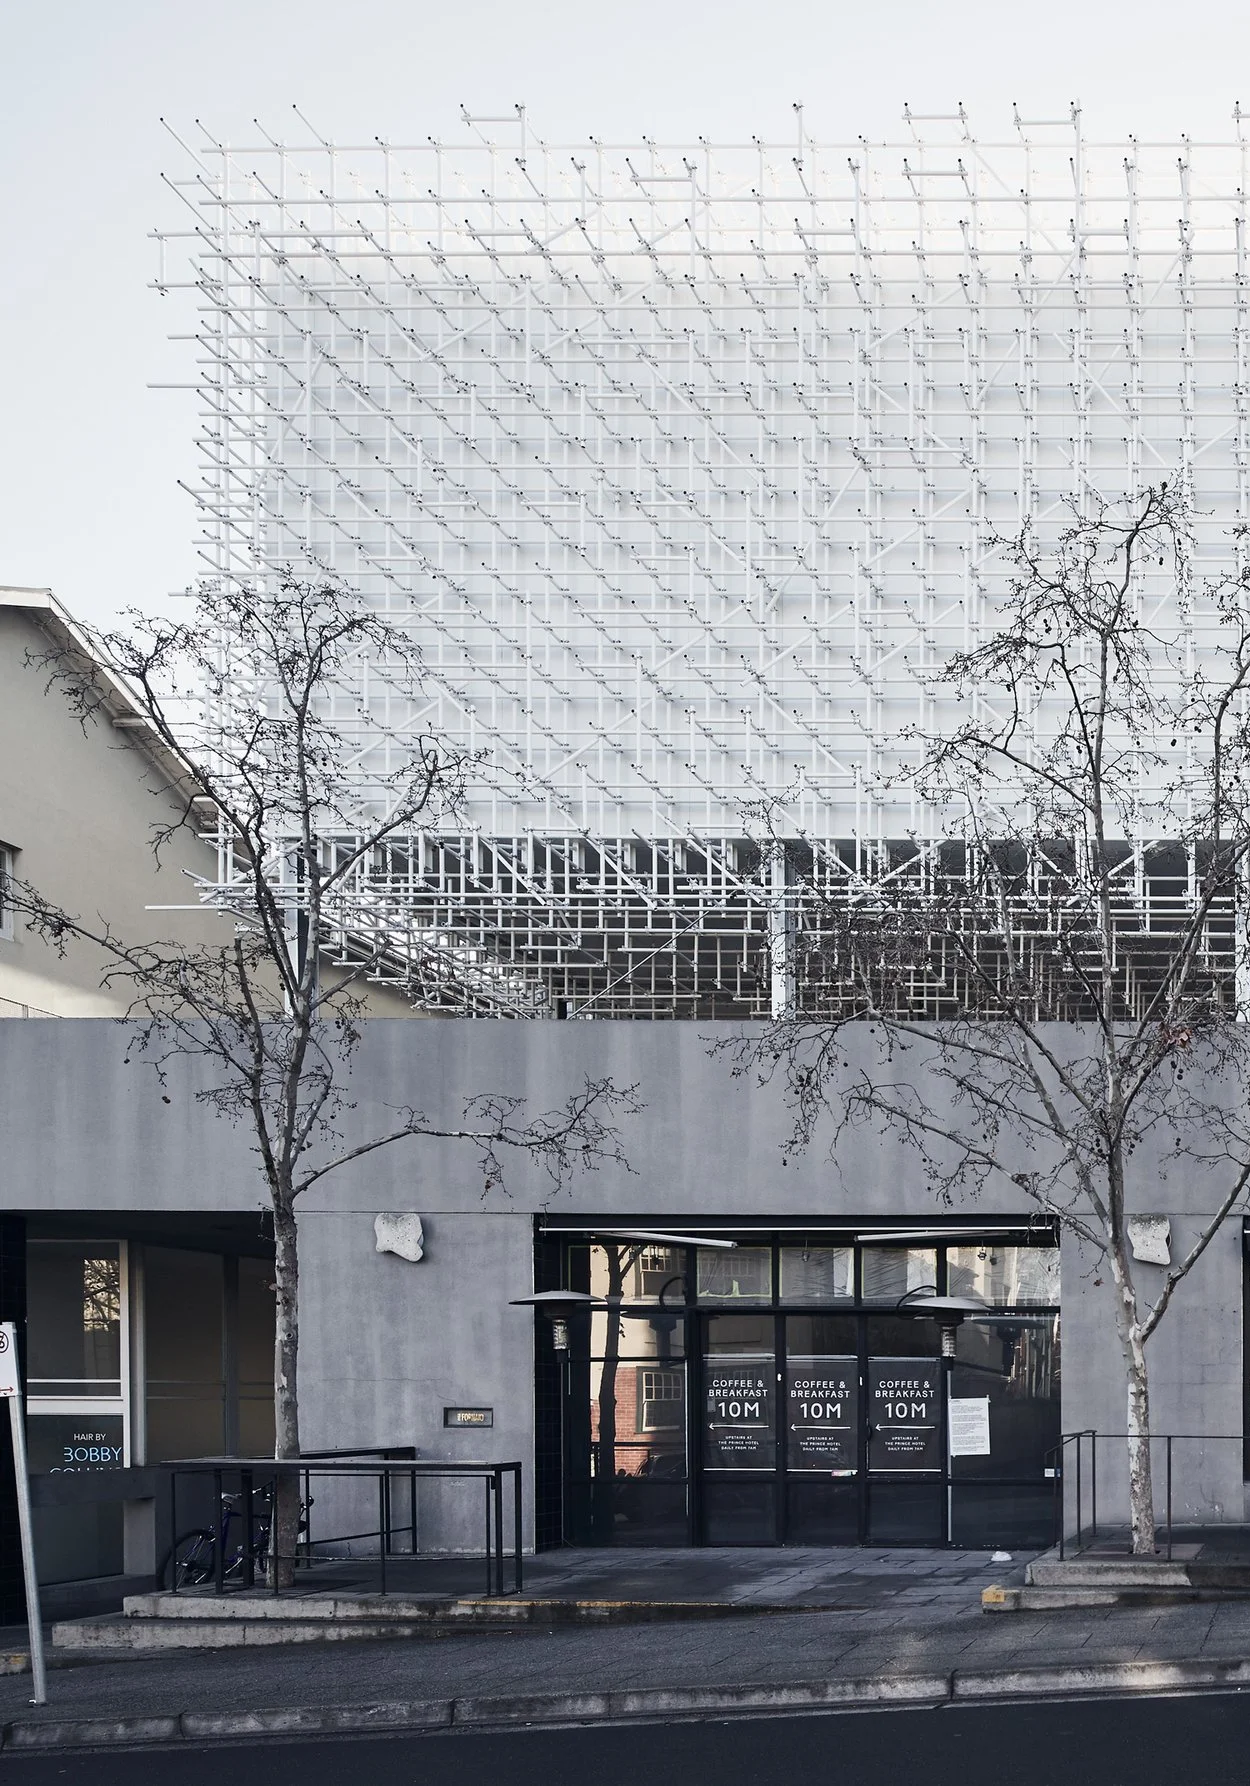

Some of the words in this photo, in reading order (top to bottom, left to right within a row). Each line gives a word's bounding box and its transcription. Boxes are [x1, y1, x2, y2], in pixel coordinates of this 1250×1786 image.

[712, 1380, 753, 1388] COFFEE
[757, 1380, 764, 1388] &
[794, 1381, 835, 1389] COFFEE
[839, 1381, 846, 1389] &
[879, 1381, 919, 1389] COFFEE
[923, 1381, 930, 1389] &
[708, 1389, 768, 1397] BREAKFAST
[790, 1390, 850, 1398] BREAKFAST
[875, 1390, 934, 1398] BREAKFAST
[718, 1402, 759, 1417] 10M
[800, 1403, 841, 1419] 10M
[885, 1403, 926, 1418] 10M
[63, 1447, 122, 1462] BOBBY
